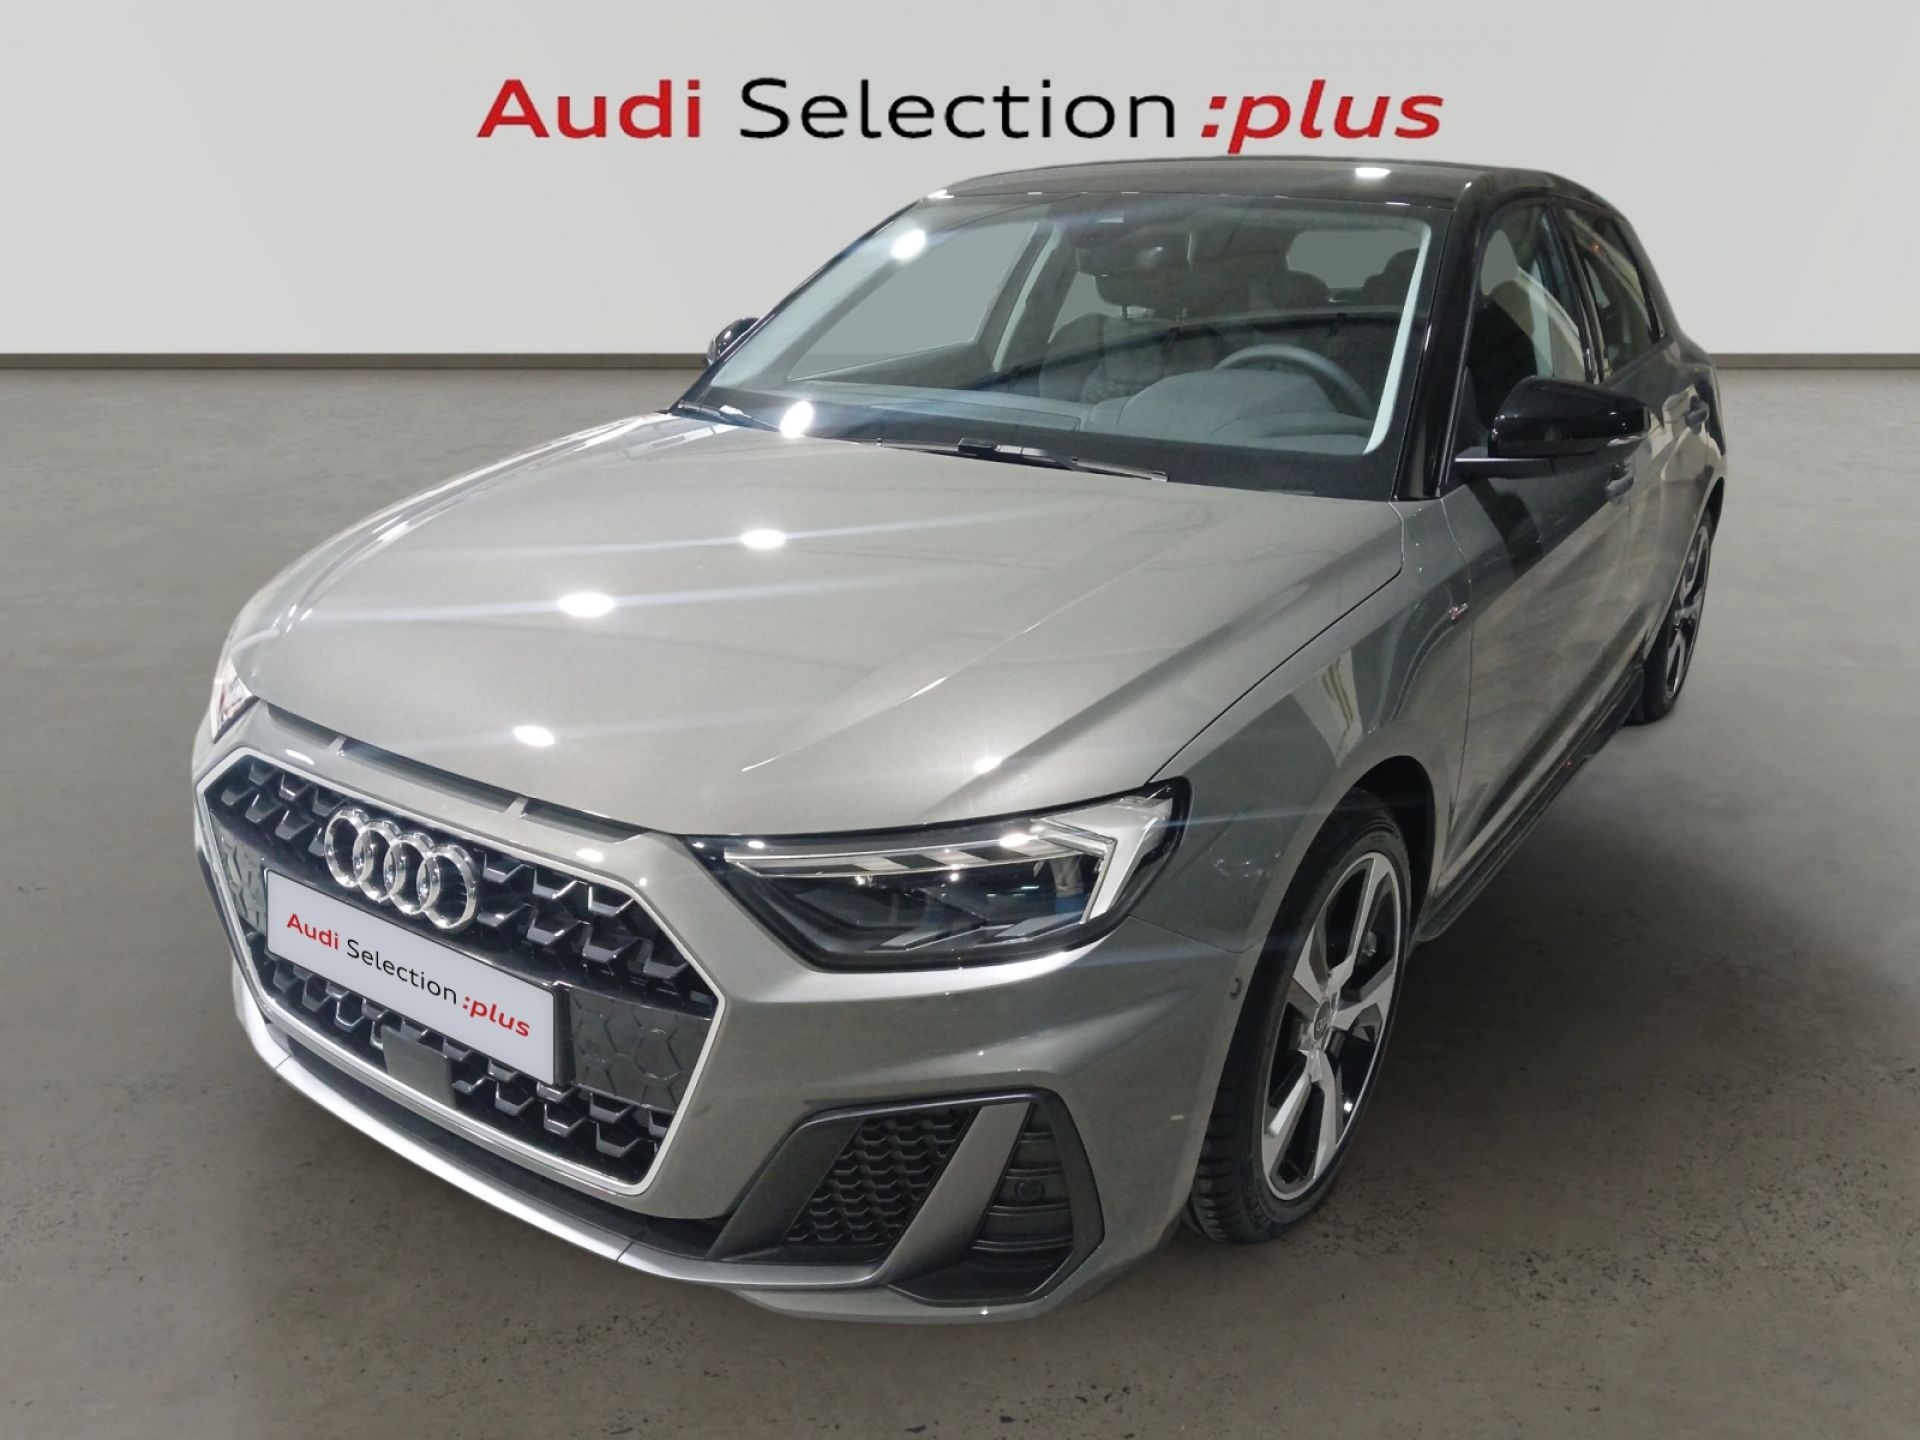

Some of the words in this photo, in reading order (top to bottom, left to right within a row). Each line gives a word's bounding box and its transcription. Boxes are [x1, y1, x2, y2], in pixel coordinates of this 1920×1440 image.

[477, 79, 700, 138] Audi
[740, 77, 1175, 139] Selection
[1202, 79, 1444, 154] :plus
[286, 913, 339, 950] Audi
[347, 939, 457, 1004] Selection
[462, 996, 531, 1037] :plus
